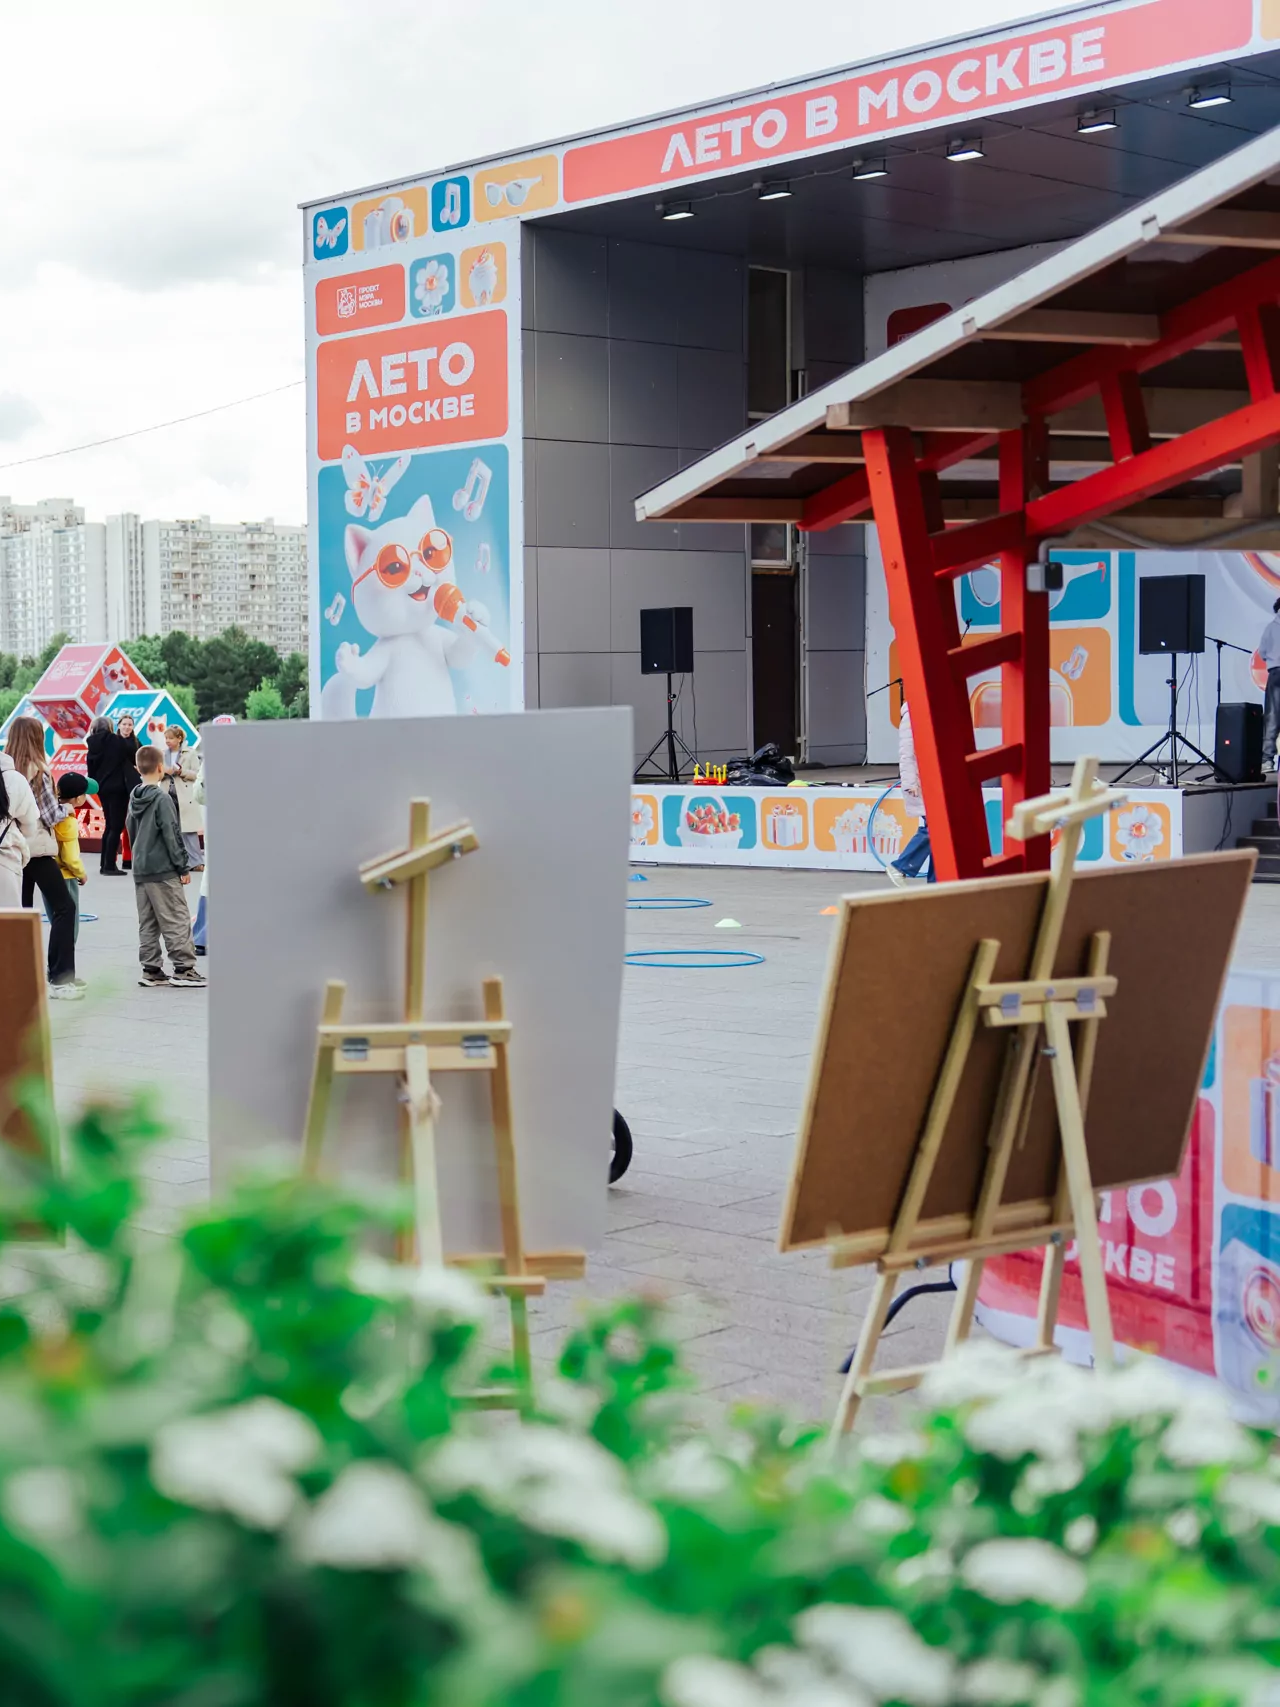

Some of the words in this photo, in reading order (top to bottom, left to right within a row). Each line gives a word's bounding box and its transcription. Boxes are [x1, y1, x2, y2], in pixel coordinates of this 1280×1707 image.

[661, 108, 788, 173] ЛЕТО
[806, 98, 838, 139] В
[858, 27, 1106, 126] МОСКВЕ
[346, 341, 475, 402] ЛЕТО
[346, 412, 361, 434] В
[369, 393, 475, 430] МОСКВЕ
[53, 749, 88, 762] ЛЕТ
